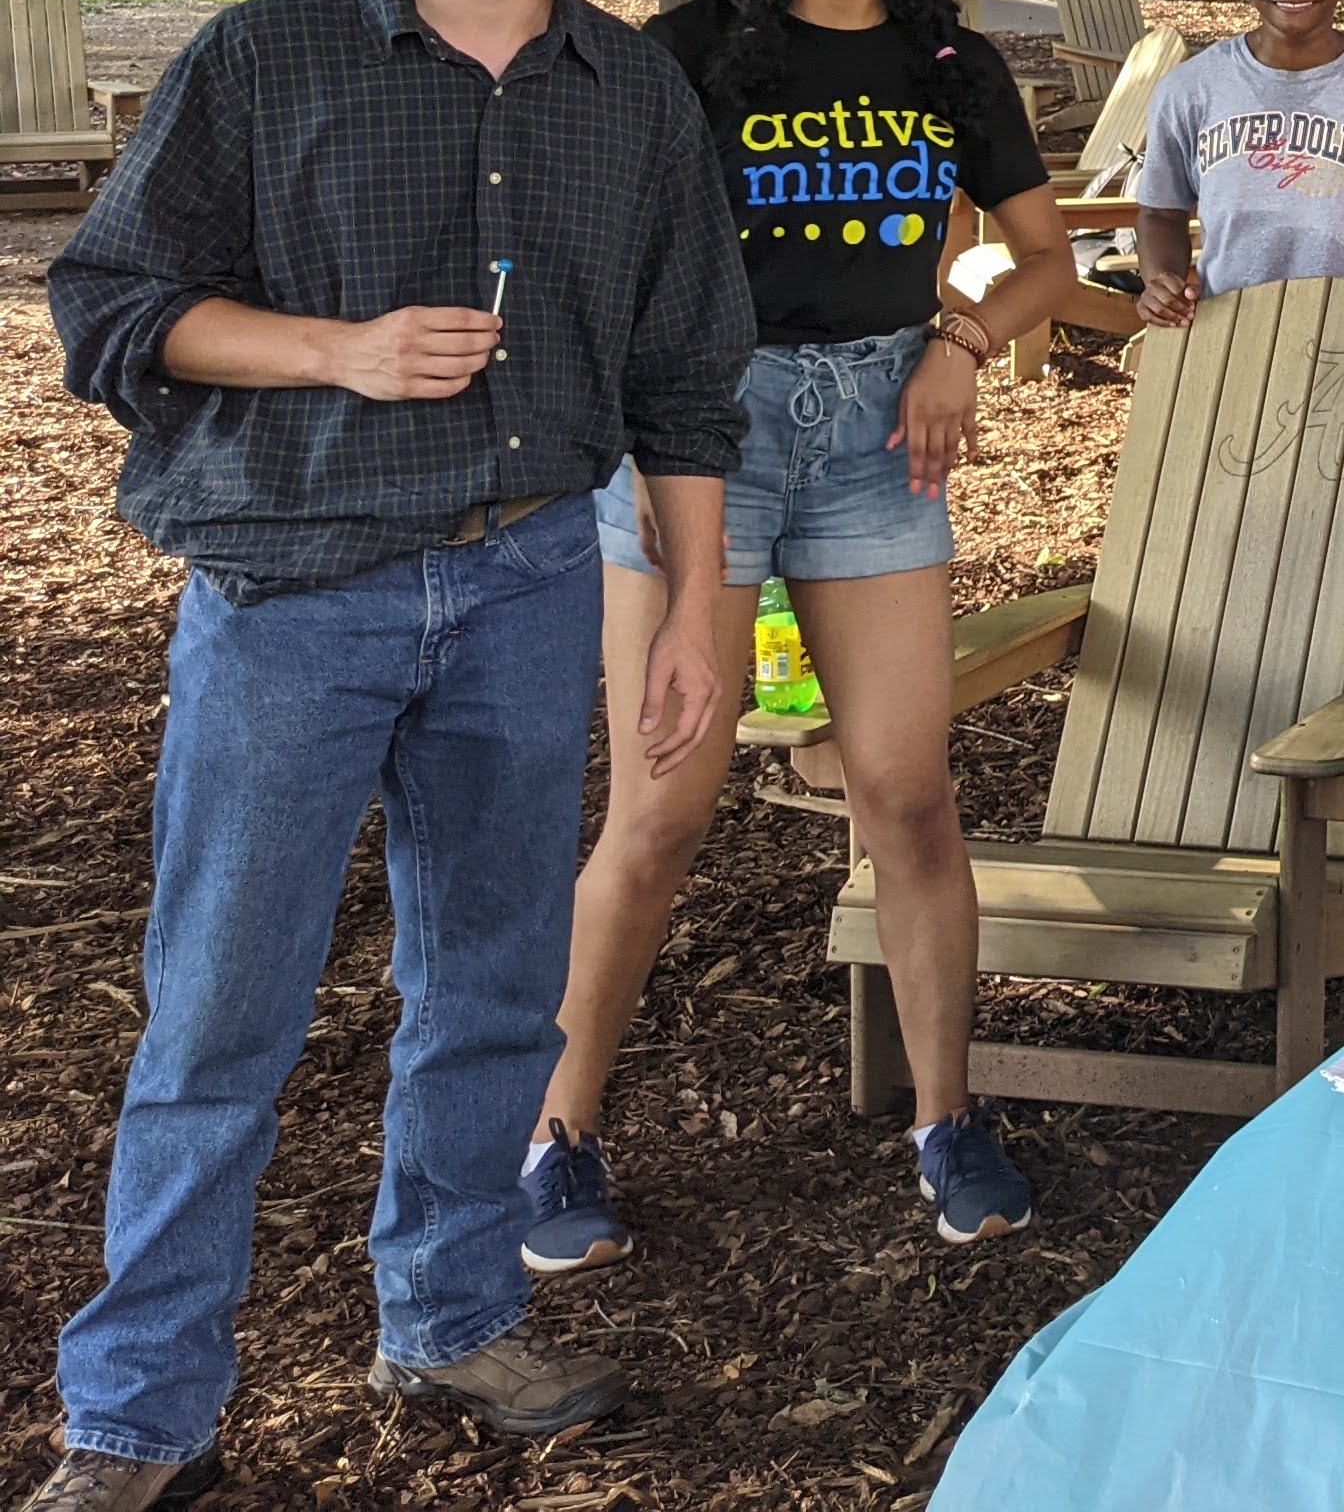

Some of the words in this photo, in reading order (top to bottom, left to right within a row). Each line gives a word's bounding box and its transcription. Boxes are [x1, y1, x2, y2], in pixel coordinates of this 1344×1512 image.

[741, 95, 955, 152] active
[1197, 111, 1285, 175] SILVER
[742, 140, 958, 206] minds
[1245, 138, 1317, 189] City
